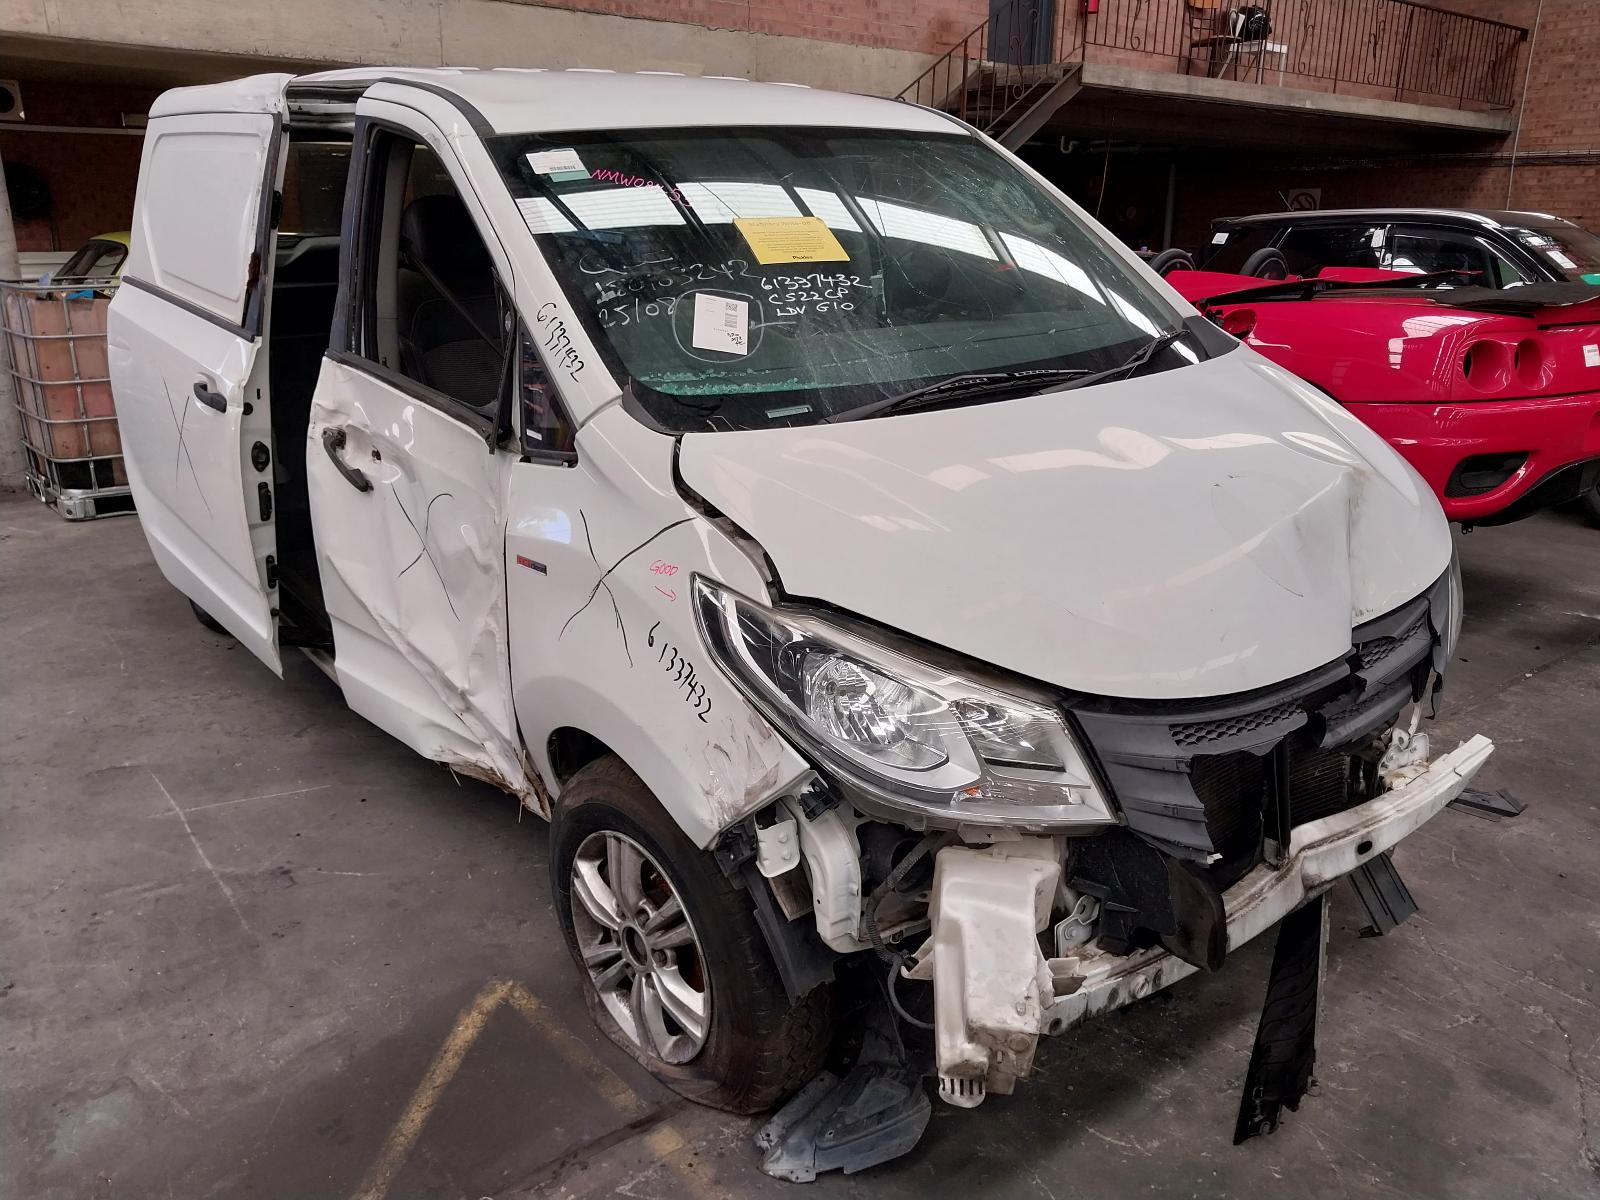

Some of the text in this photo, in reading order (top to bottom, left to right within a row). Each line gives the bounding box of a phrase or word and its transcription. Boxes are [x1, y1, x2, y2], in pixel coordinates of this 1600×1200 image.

[761, 273, 872, 290] 61337432
[776, 305, 806, 316] LDV
[649, 559, 679, 577] GOOD
